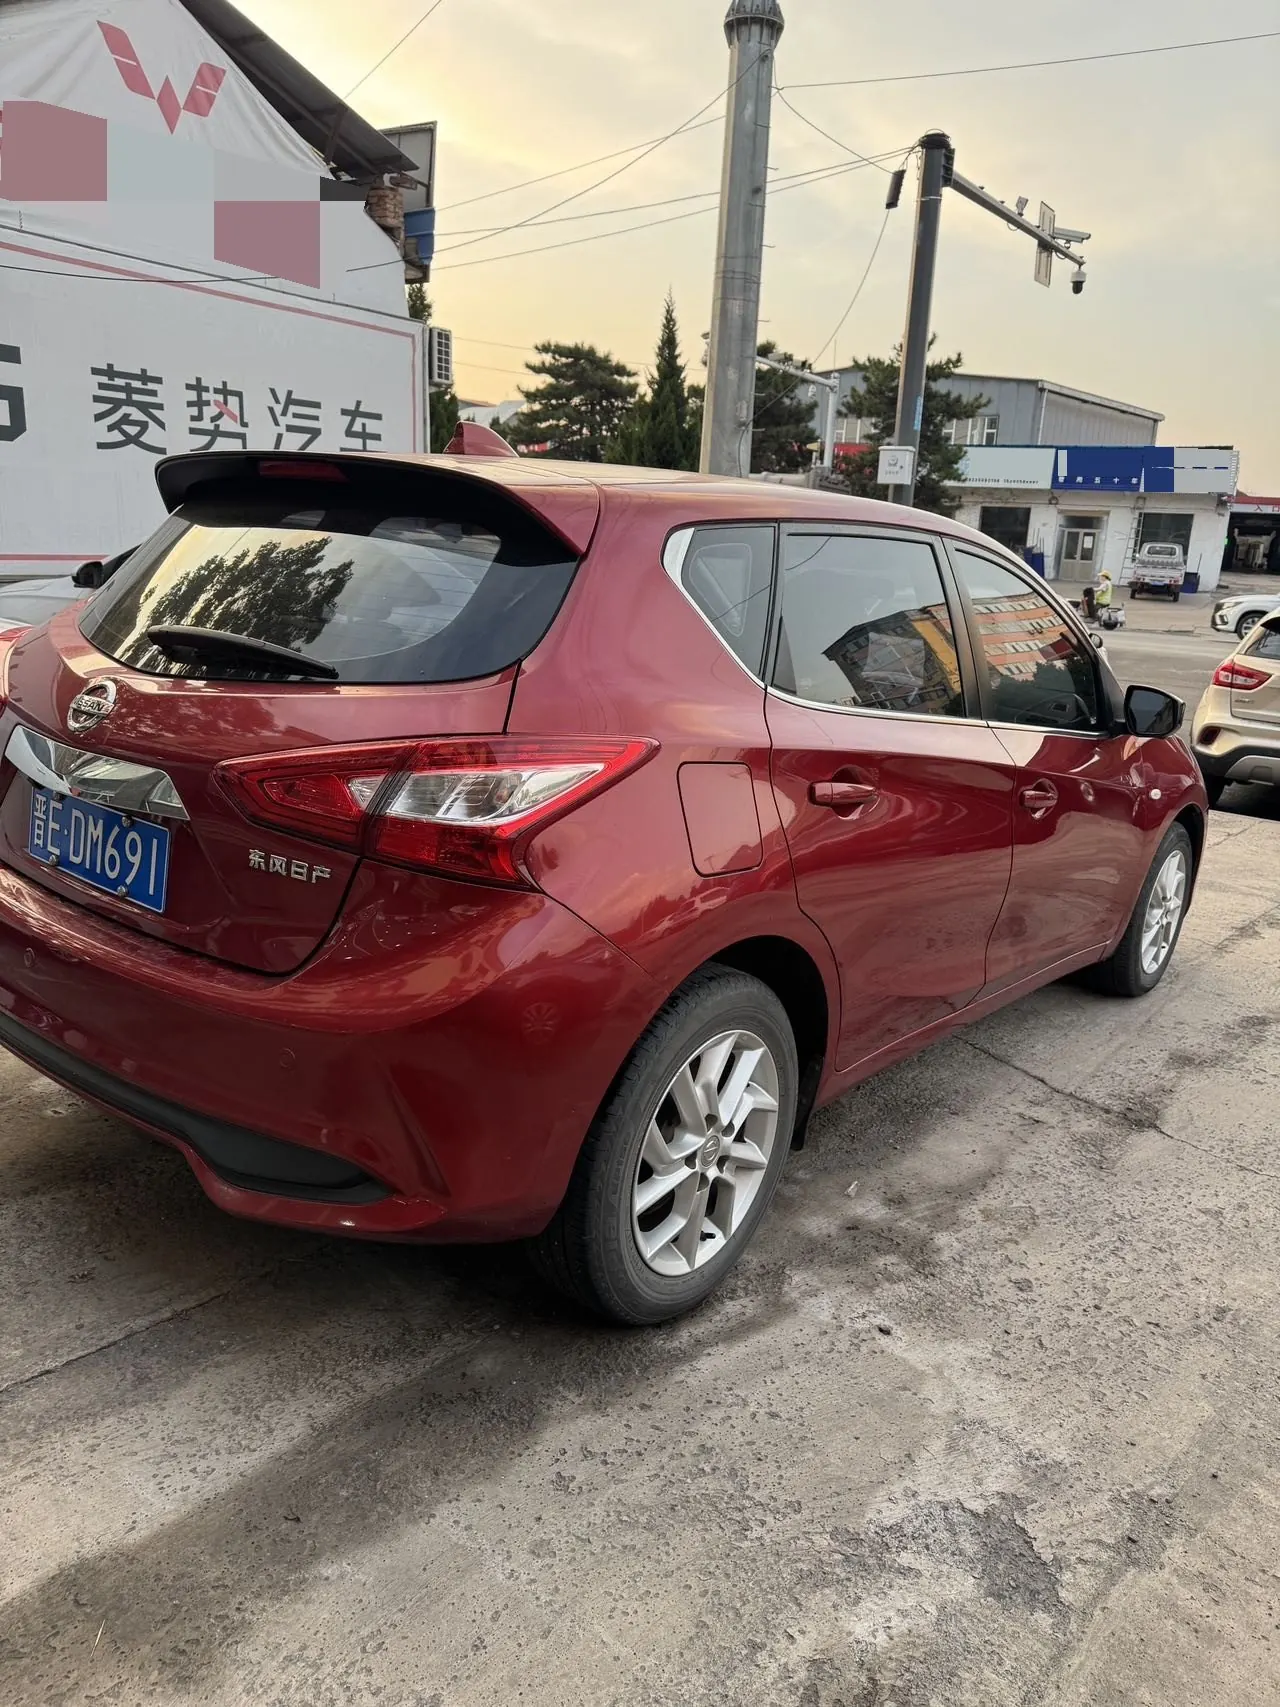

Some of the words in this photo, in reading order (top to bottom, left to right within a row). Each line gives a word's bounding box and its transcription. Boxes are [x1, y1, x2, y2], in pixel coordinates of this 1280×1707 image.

[90, 362, 383, 455] 菱势汽车
[248, 848, 332, 884] 东风日产
